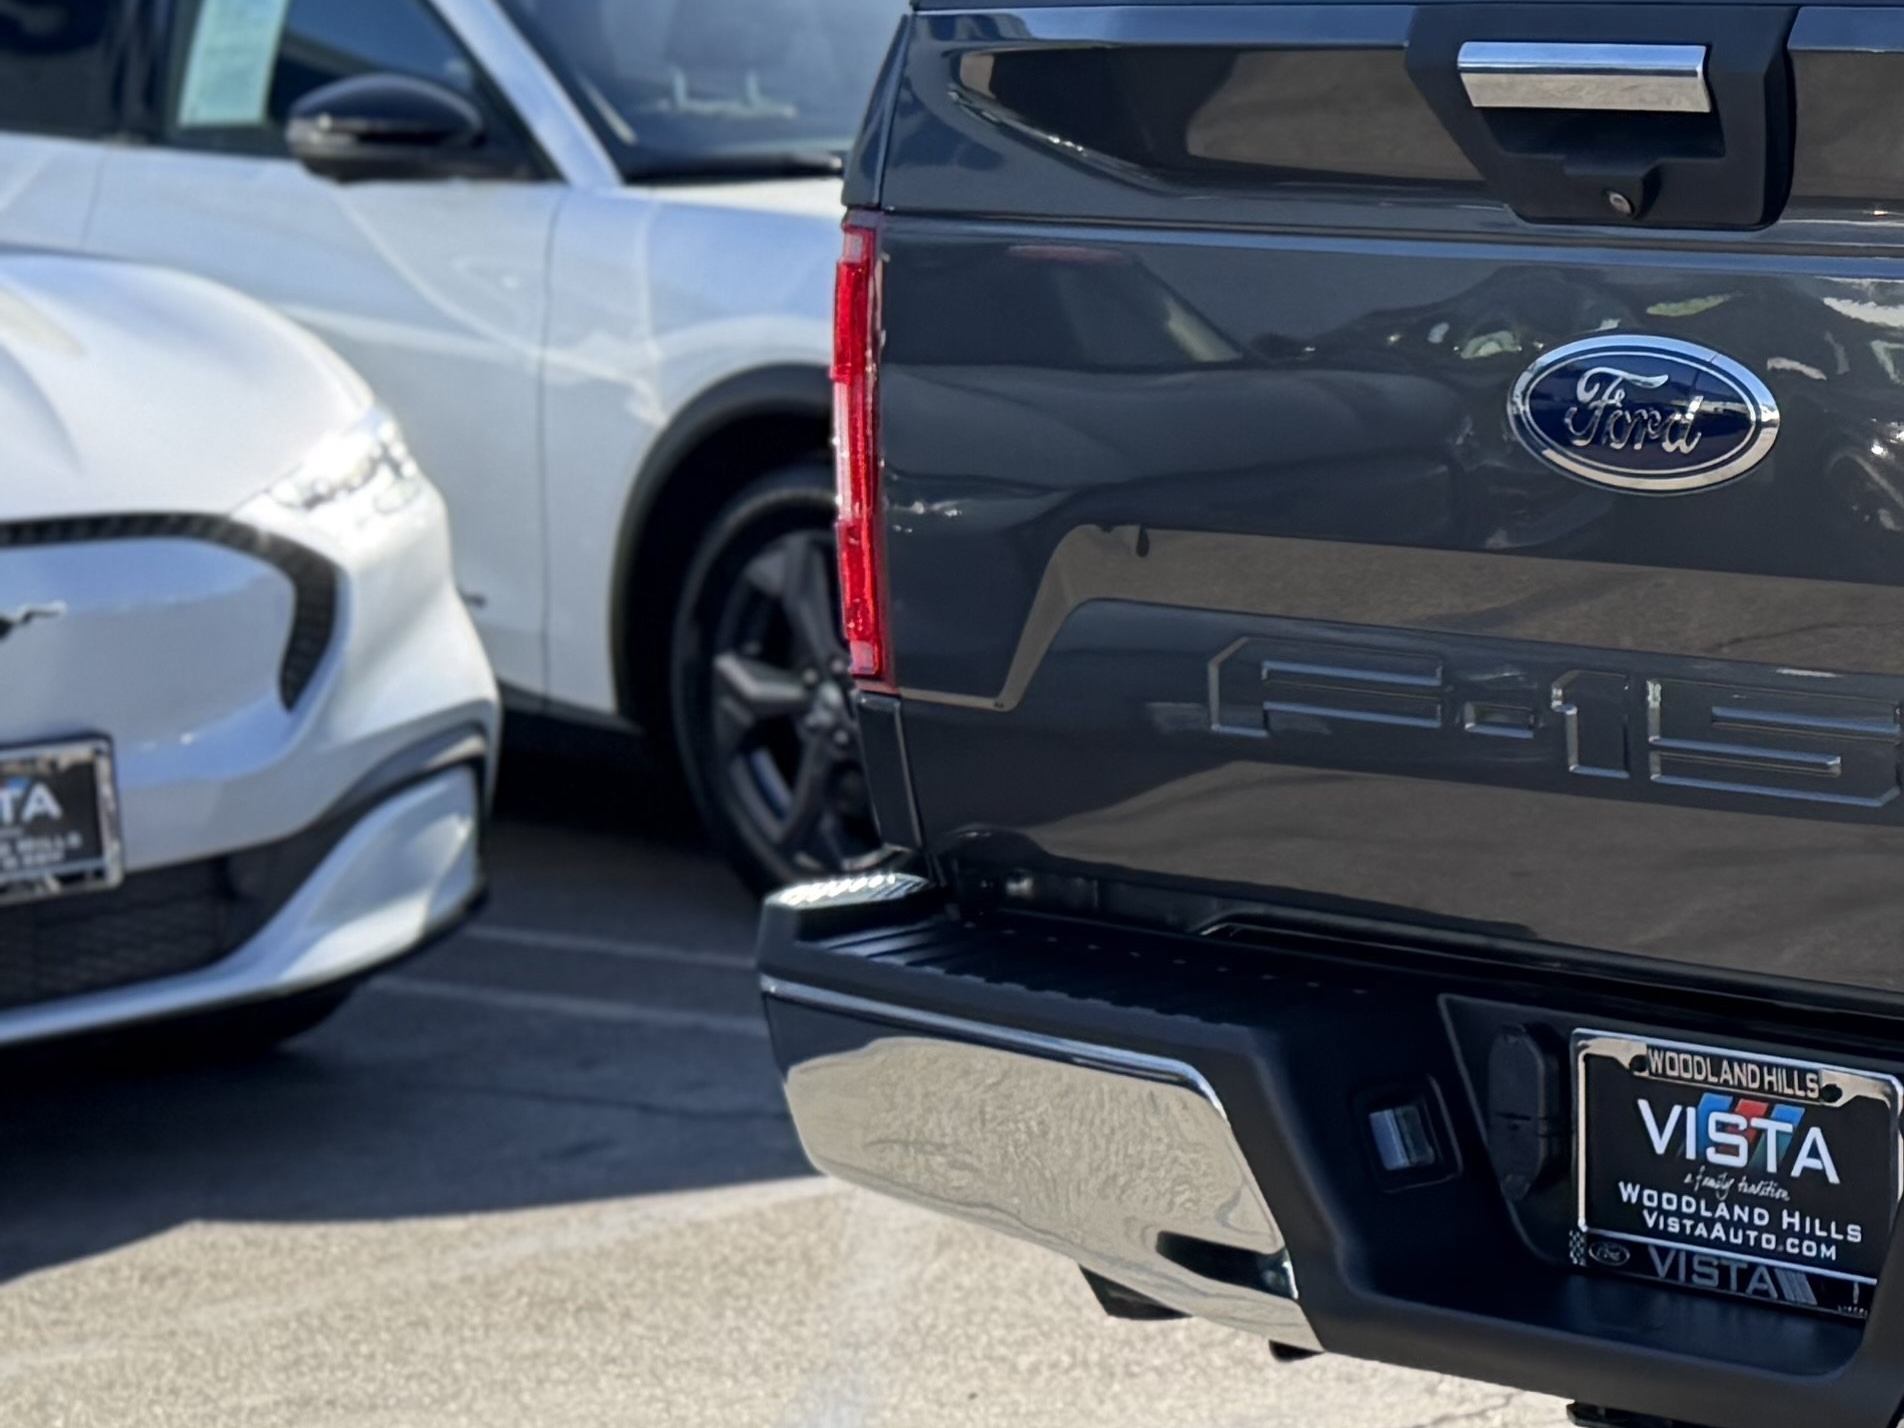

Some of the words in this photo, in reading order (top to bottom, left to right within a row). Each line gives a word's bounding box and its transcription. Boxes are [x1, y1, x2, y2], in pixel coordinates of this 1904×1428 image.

[1564, 366, 1705, 455] Ford
[1647, 1047, 1761, 1089] WOODLAND
[1763, 1065, 1820, 1099] HILLS
[1637, 1097, 1841, 1185] VISTA
[1648, 1245, 1779, 1299] VISTA
